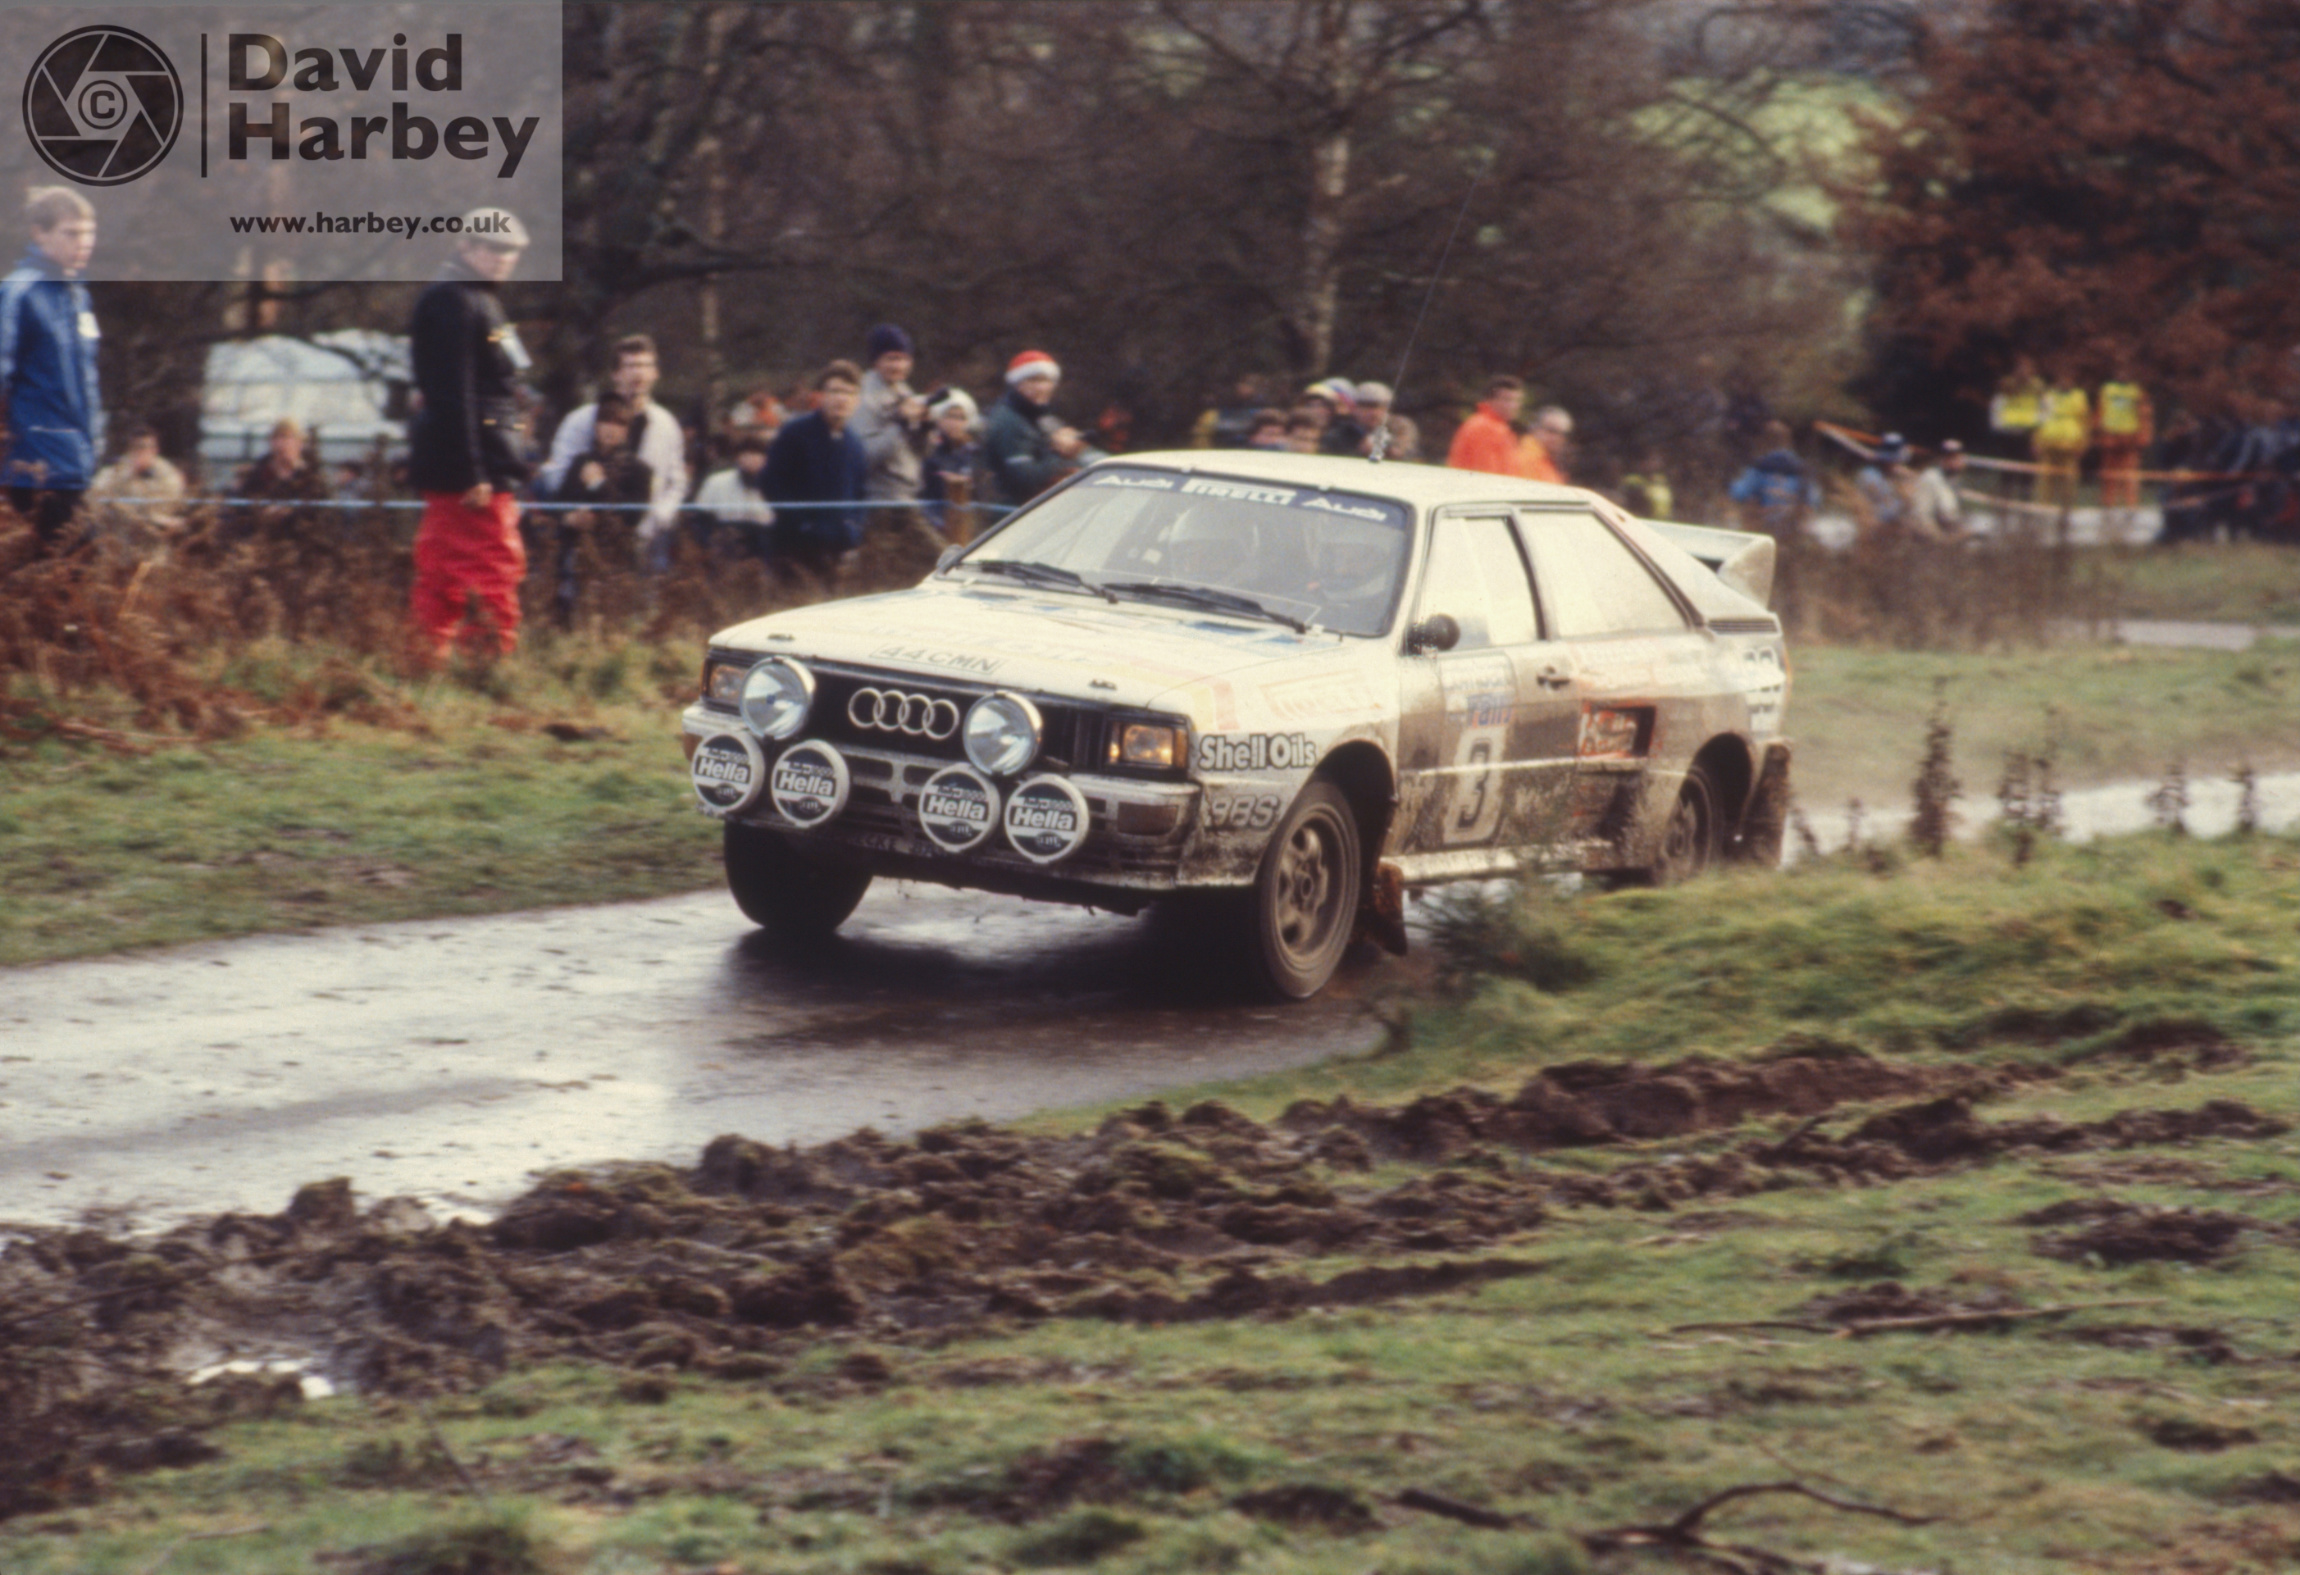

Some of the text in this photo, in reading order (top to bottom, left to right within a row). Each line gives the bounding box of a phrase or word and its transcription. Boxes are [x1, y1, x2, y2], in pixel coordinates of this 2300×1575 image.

[1093, 474, 1388, 522] Audi PIRELLI Audi
[1199, 733, 1317, 772] Shell Oils
[698, 757, 749, 783] Hella
[1457, 736, 1494, 829] 3
[778, 771, 834, 797] Hella
[926, 795, 986, 821] Hella
[1013, 808, 1074, 832] Hella
